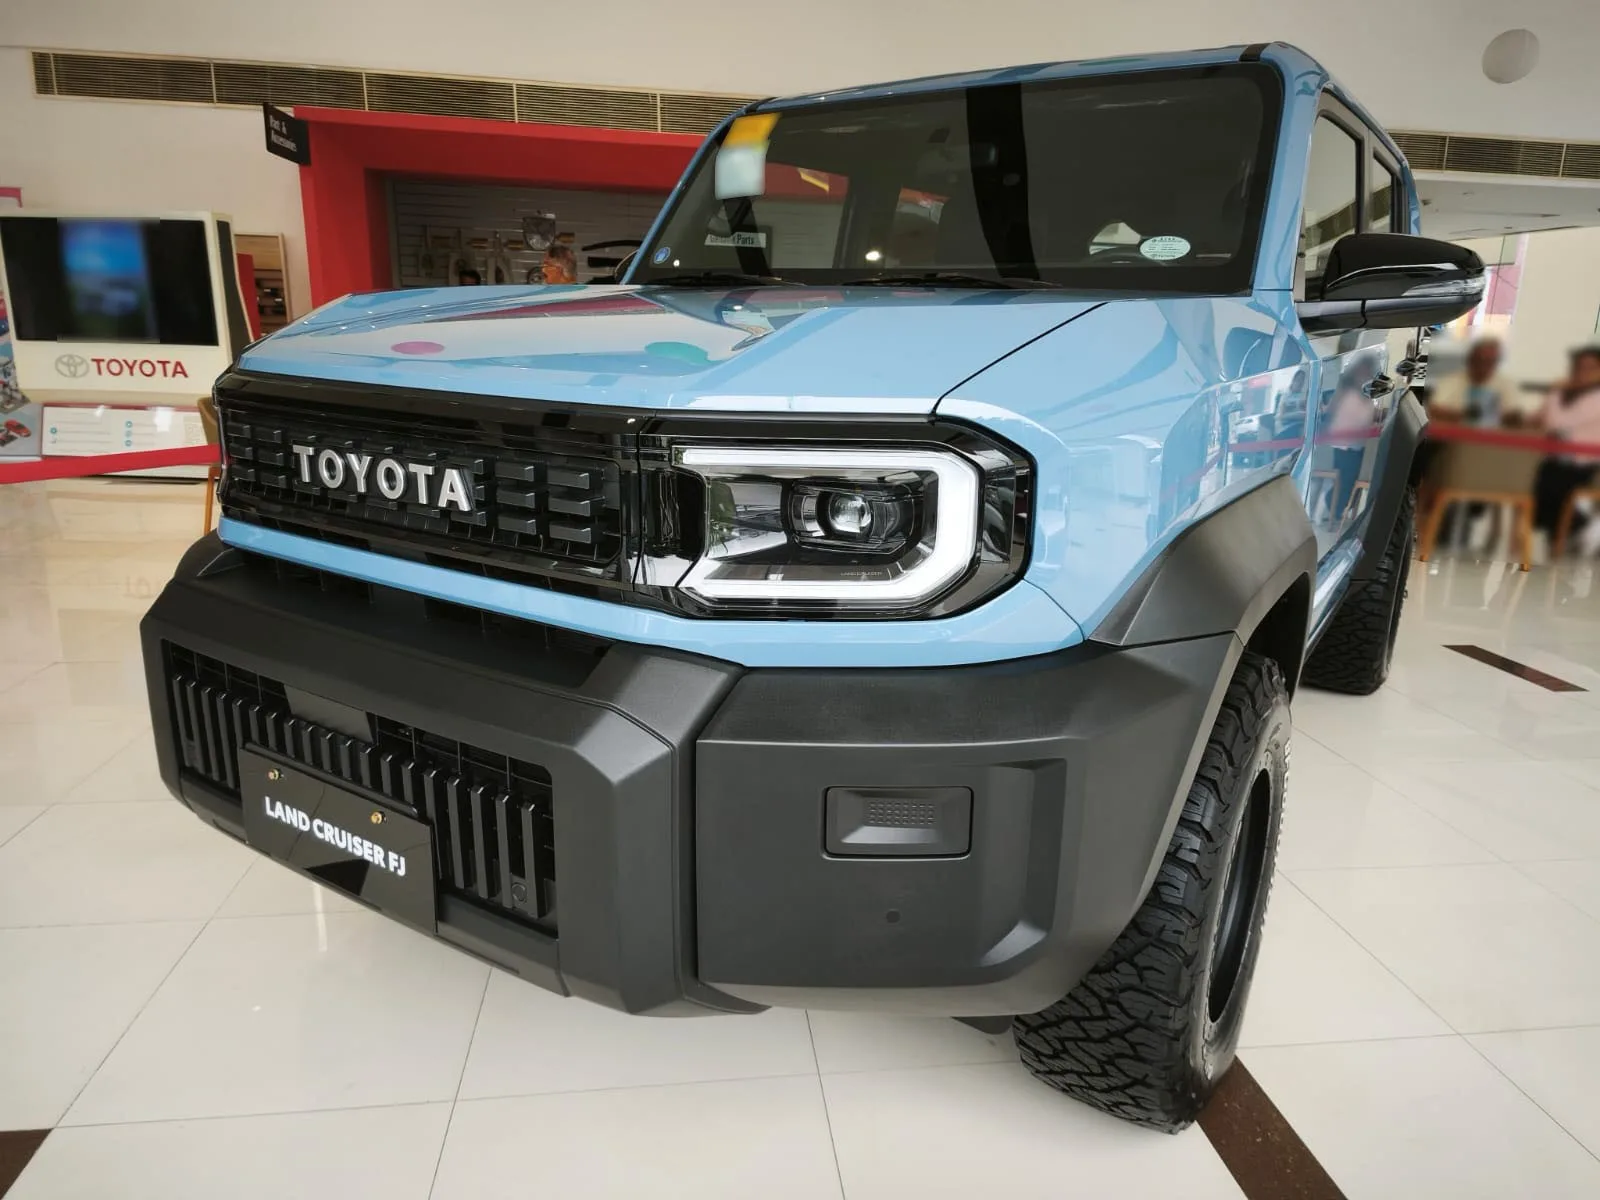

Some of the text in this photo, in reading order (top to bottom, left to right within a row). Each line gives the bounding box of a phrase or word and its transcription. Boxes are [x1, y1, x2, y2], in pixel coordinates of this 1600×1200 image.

[91, 358, 188, 378] TOYOTA
[293, 445, 472, 511] TOYOTA
[264, 795, 407, 877] LAND CRUISER FJ
